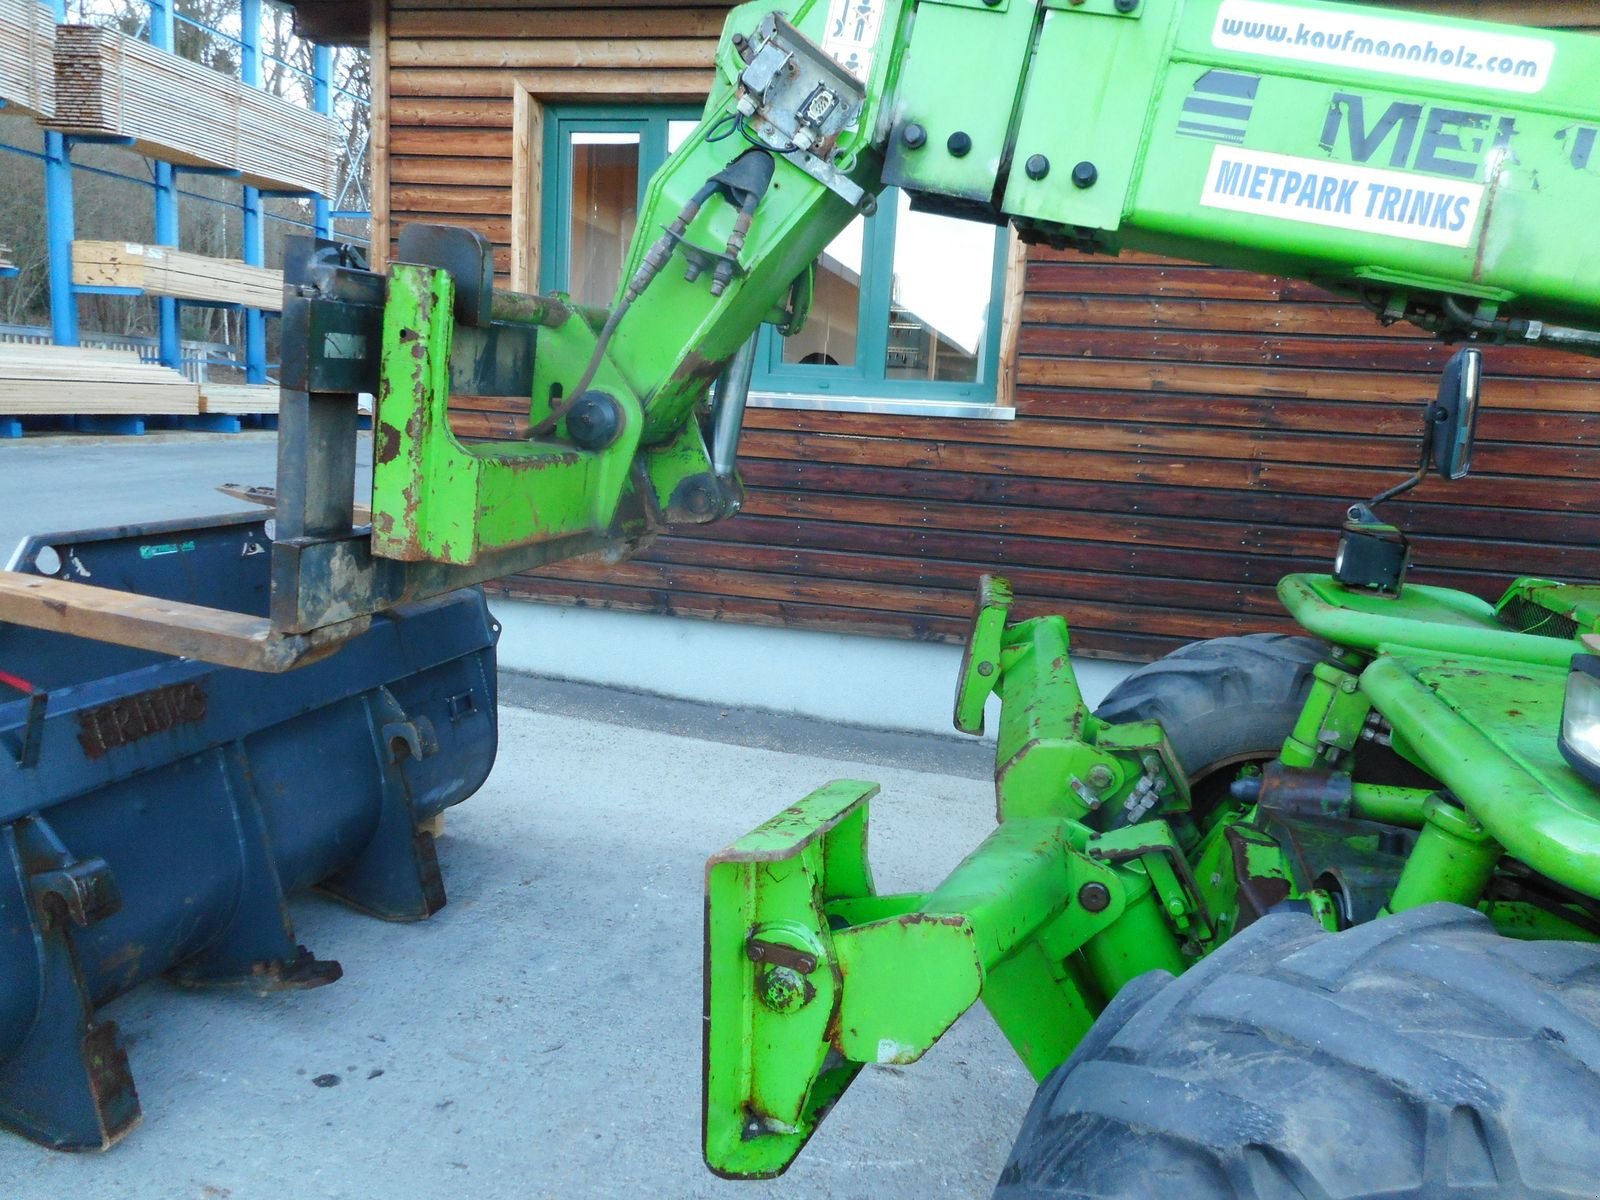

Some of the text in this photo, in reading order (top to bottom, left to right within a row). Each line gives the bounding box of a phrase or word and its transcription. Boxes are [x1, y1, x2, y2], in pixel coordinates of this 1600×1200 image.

[1222, 18, 1538, 77] www.kaufmannholz.com
[1214, 160, 1470, 232] MIETPARK TRINKS
